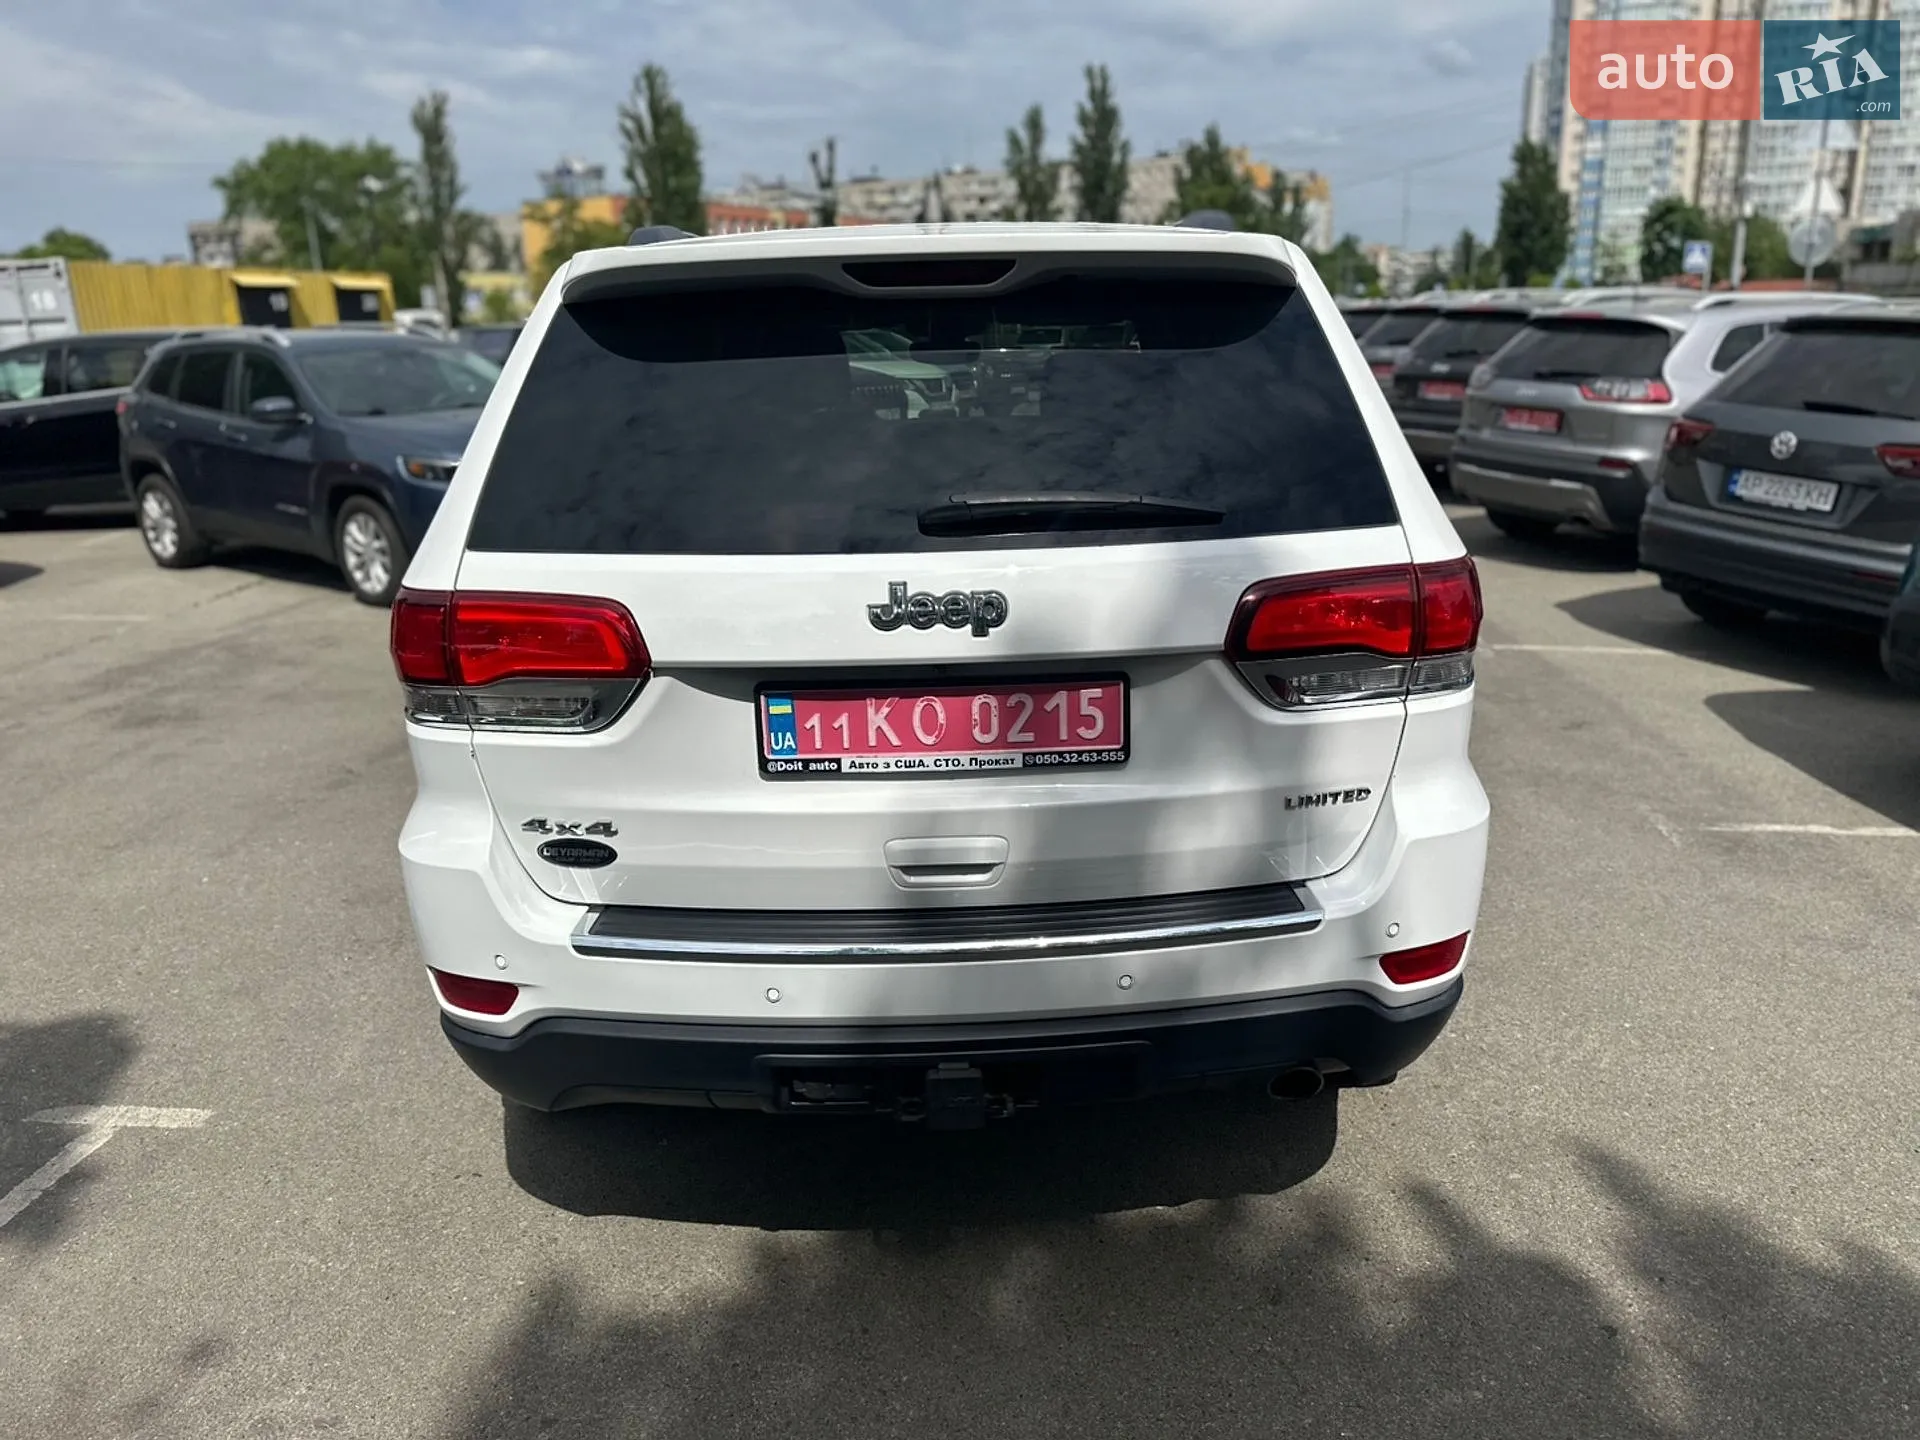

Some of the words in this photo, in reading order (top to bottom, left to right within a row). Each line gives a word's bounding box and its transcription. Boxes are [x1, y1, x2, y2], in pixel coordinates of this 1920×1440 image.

[866, 581, 1008, 637] Jeep
[804, 712, 850, 750] 11
[866, 696, 946, 747] KO
[971, 688, 1104, 744] 0215
[770, 732, 796, 750] UA
[848, 759, 879, 769] Авто
[894, 758, 930, 769] США.
[933, 757, 965, 768] СТО.
[969, 757, 1016, 769] Прокат
[1035, 751, 1125, 765] 050-32-63-555
[1284, 787, 1371, 811] LIMITED
[521, 818, 619, 838] 4x4
